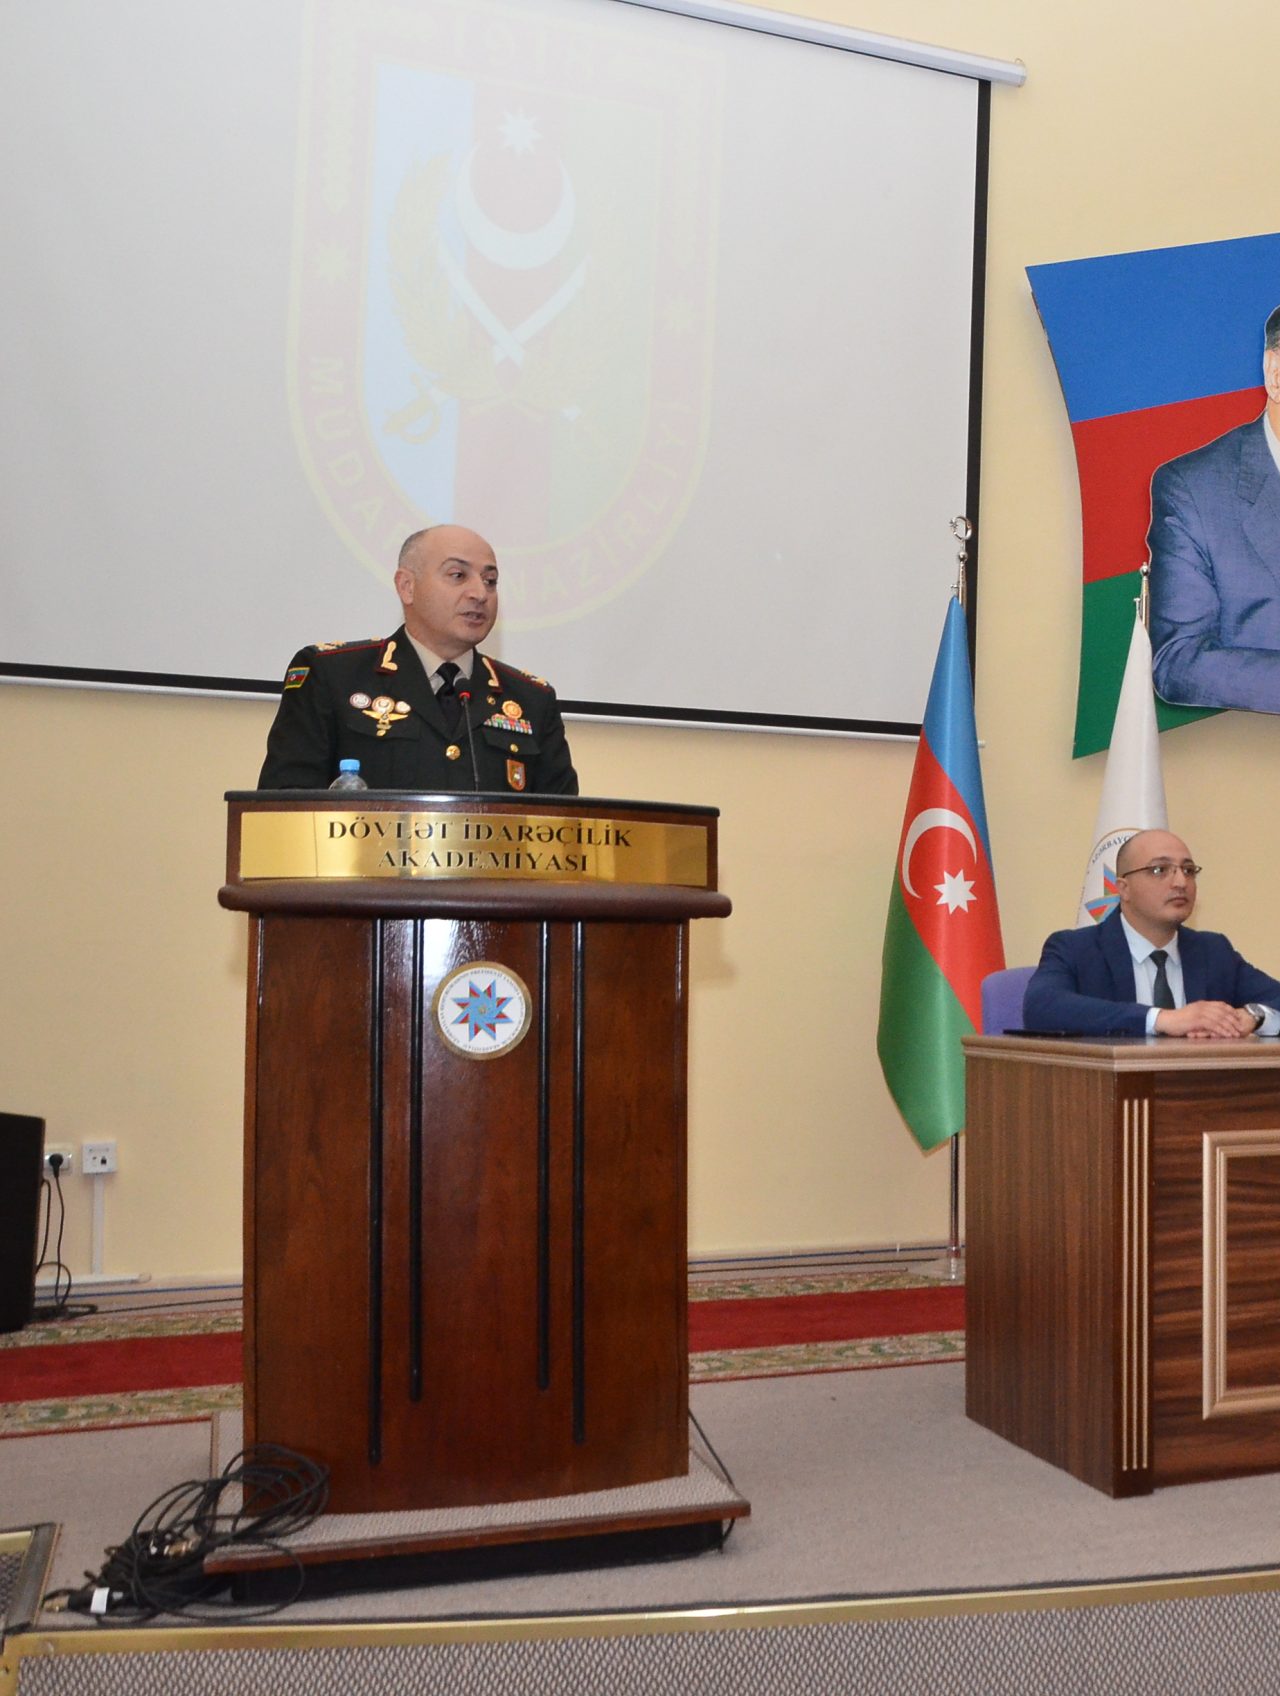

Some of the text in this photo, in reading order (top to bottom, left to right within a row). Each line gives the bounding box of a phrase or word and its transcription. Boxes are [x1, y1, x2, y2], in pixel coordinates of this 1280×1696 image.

[309, 355, 413, 550] MÜDAF
[328, 816, 632, 847] DÖVLƏT İDARƏÇİLİK
[379, 848, 587, 871] AKADEMİYASI
